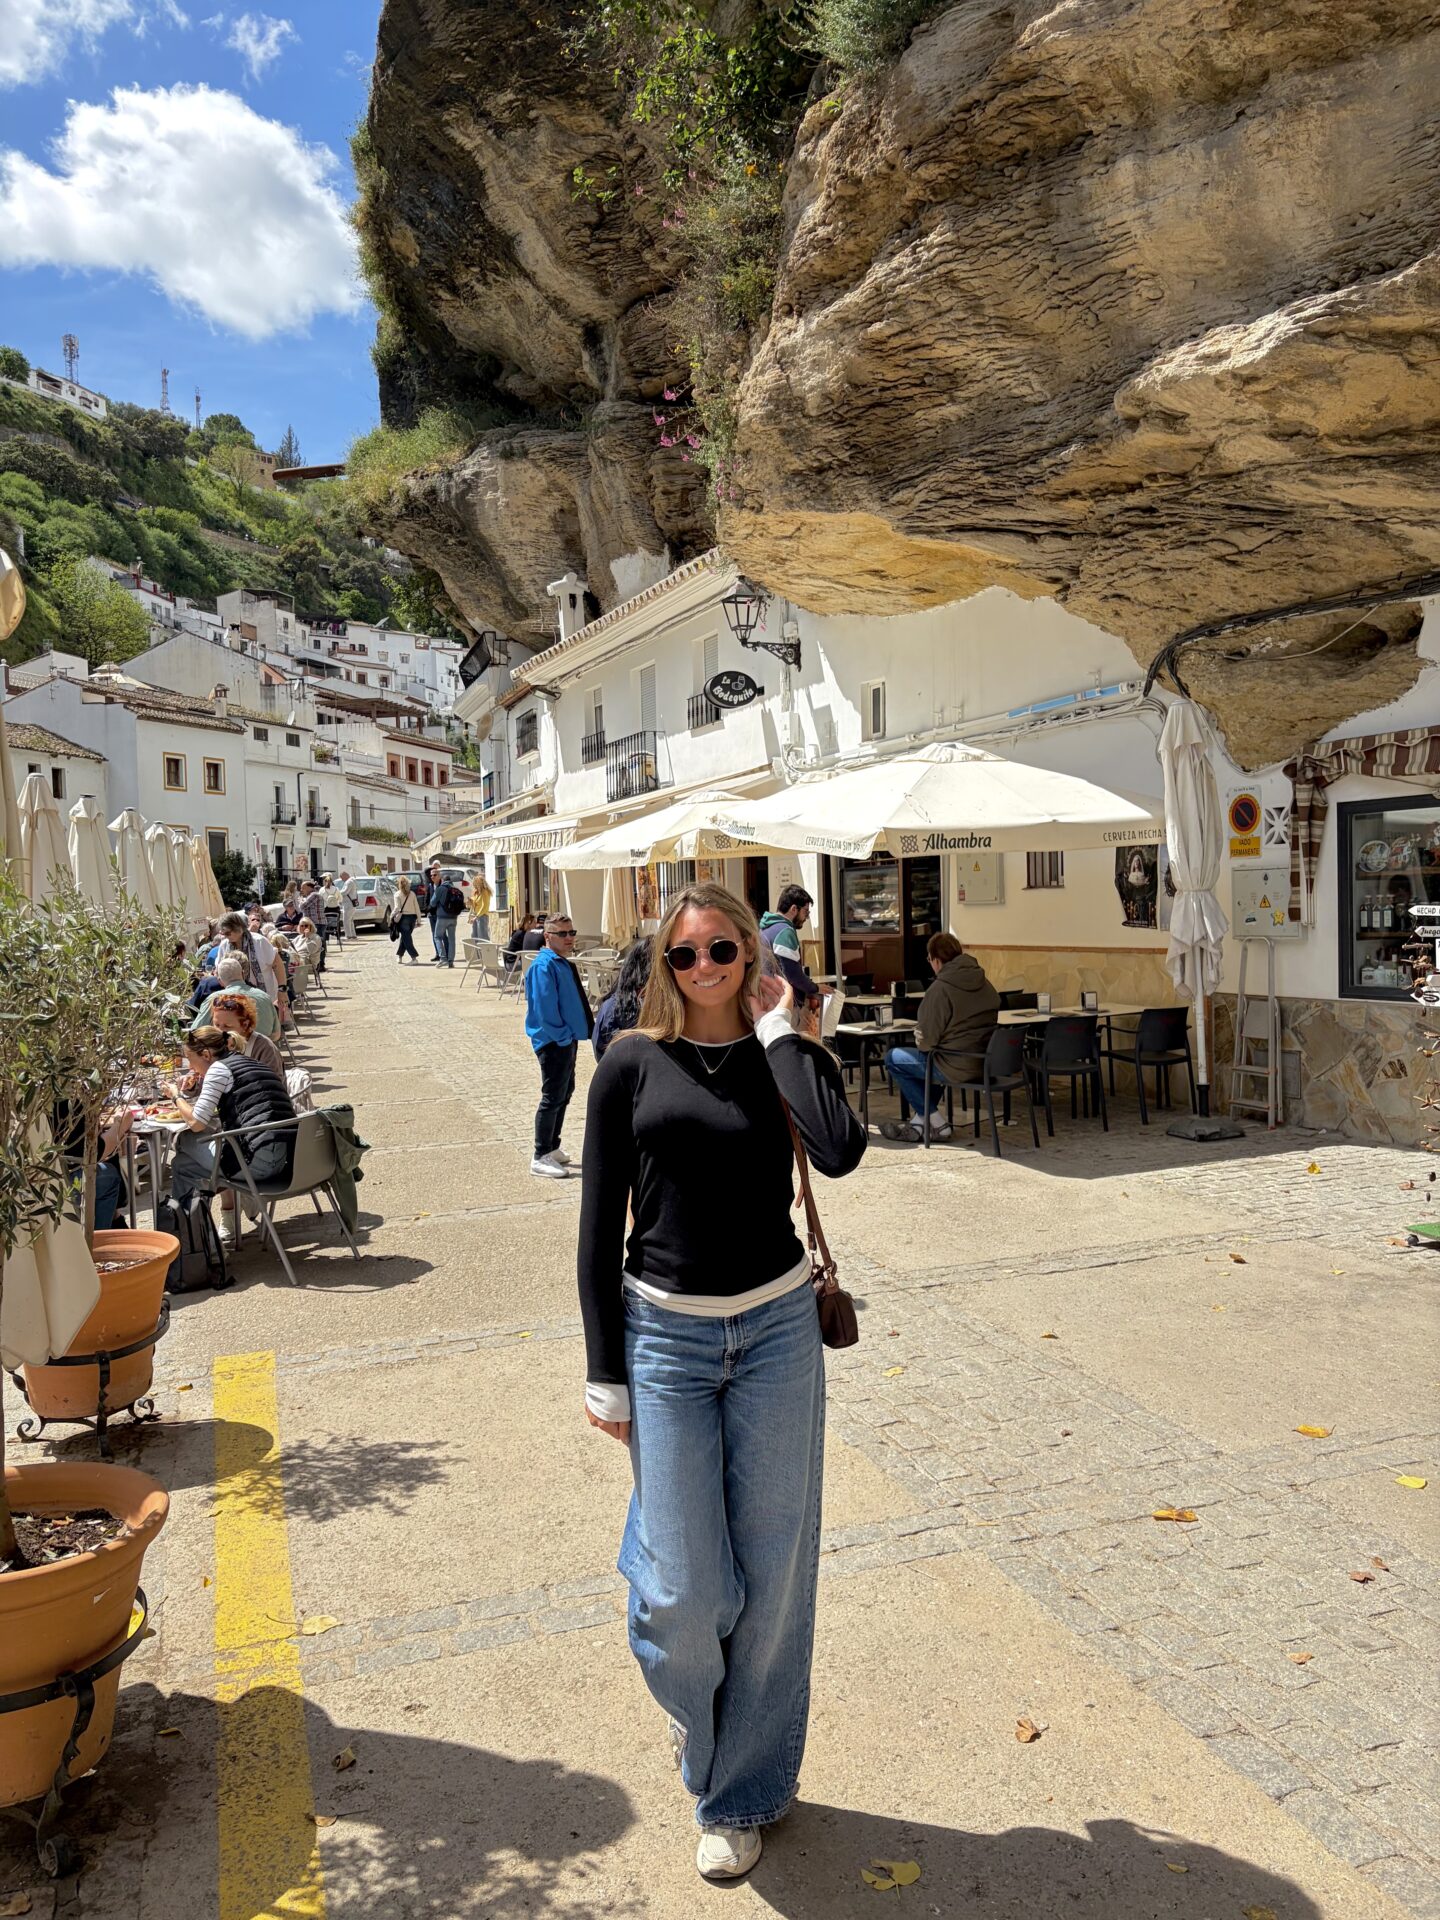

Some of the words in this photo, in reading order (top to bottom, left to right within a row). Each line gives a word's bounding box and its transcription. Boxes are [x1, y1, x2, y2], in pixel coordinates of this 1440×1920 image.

[721, 676, 731, 684] La
[712, 685, 755, 705] Bodeguita
[500, 838, 511, 853] LA
[514, 830, 564, 852] BODEGUITA
[805, 835, 825, 847] CERVEZA
[826, 837, 842, 850] HECHA
[921, 831, 992, 853] Alhambra
[1103, 830, 1137, 842] CERVEZA
[1138, 828, 1163, 839] HECHA
